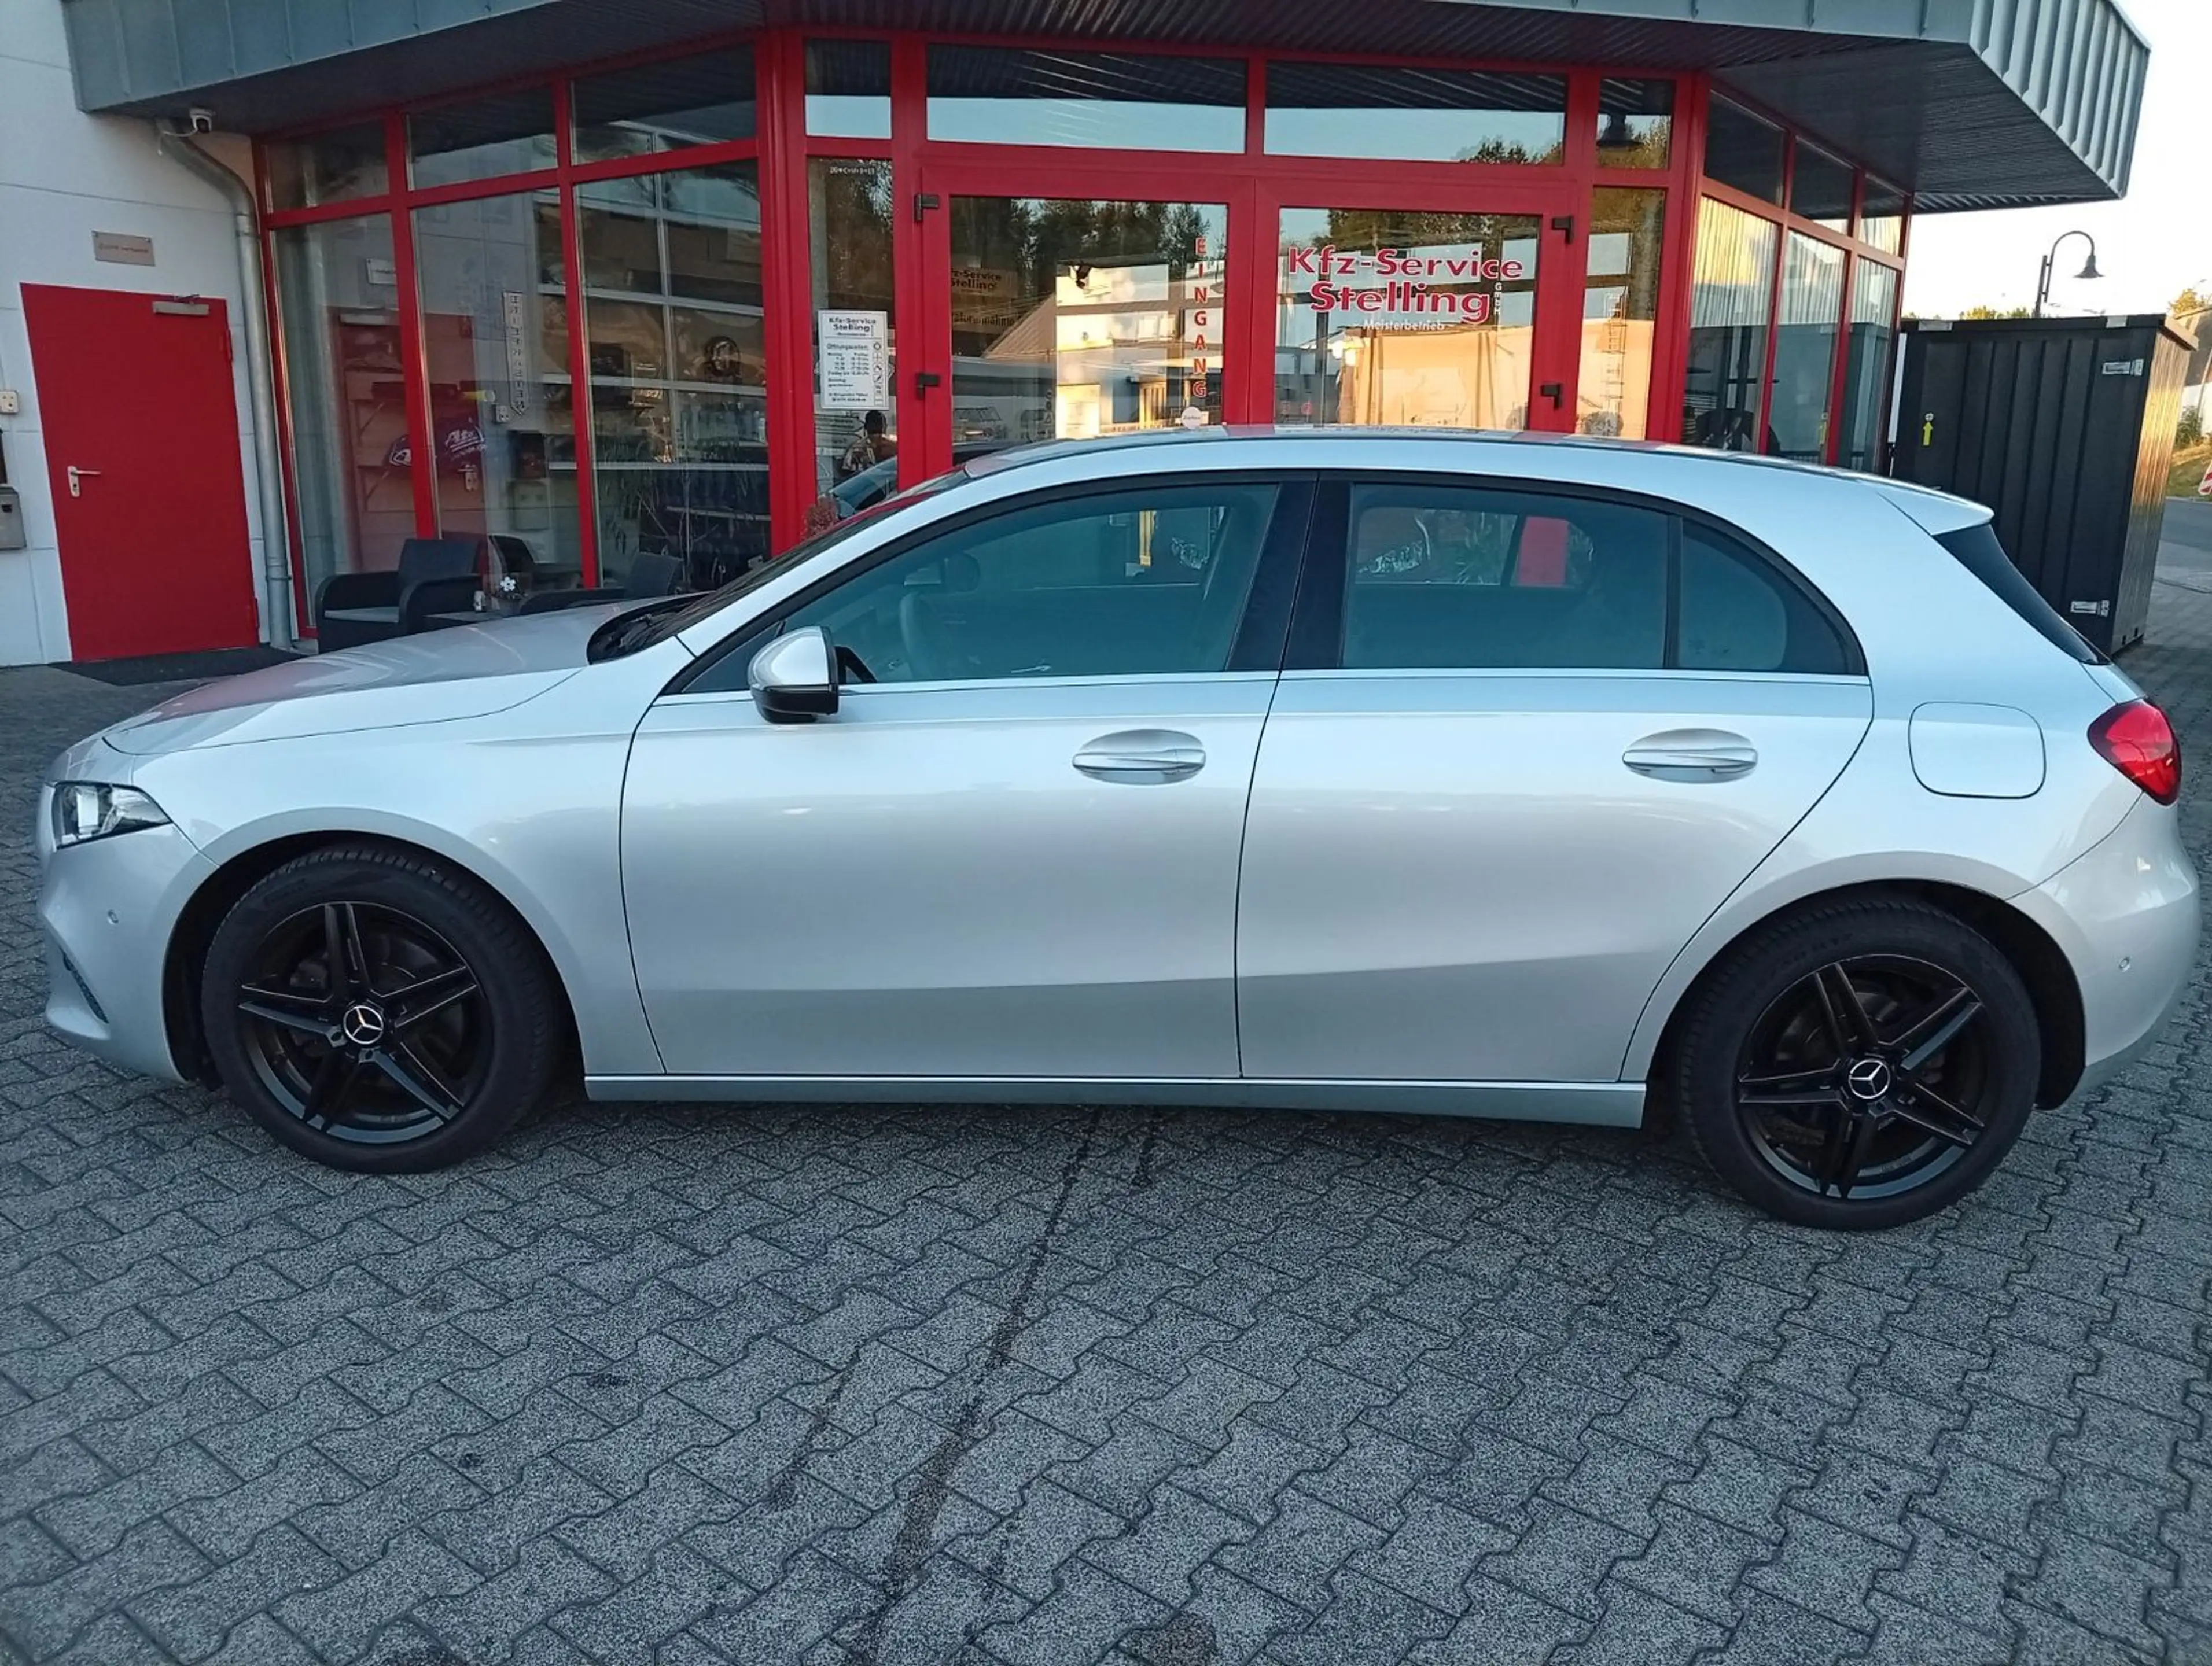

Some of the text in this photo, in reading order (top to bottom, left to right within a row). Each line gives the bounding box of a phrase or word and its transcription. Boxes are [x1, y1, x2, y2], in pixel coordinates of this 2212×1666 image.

[1288, 245, 1523, 279] Kfz-Service
[1193, 236, 1208, 399] EINGANG
[1311, 280, 1490, 324] Stelling
[1363, 319, 1446, 331] Meisterbetrieb
